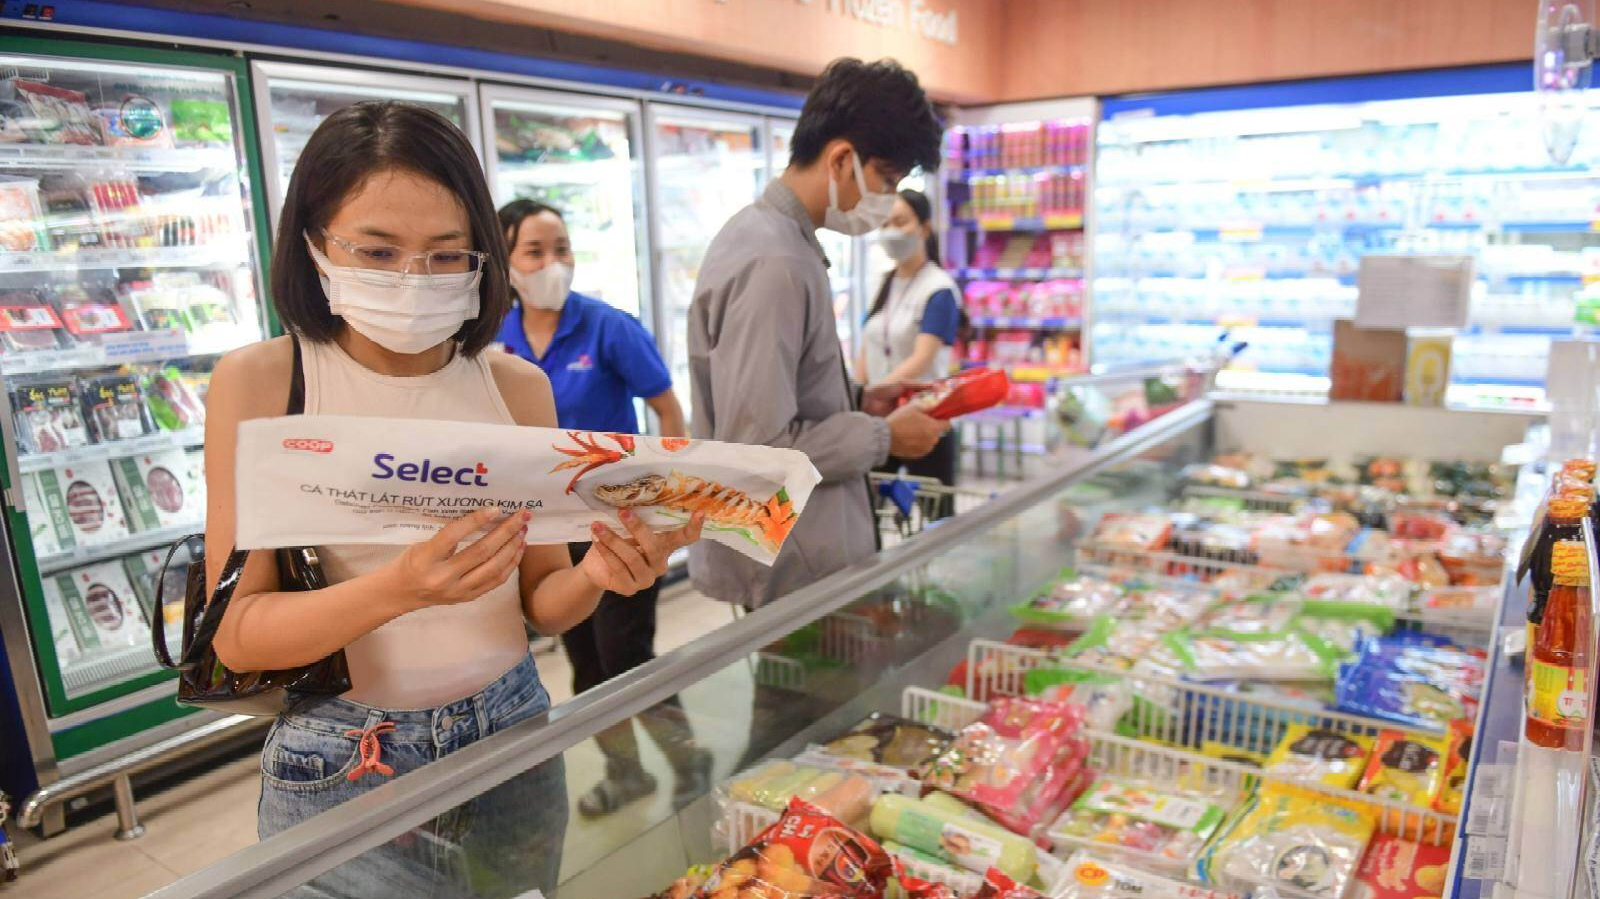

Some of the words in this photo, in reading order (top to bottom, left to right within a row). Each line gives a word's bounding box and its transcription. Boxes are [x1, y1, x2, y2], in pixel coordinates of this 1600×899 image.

[371, 453, 489, 487] Select
[402, 494, 435, 508] RÚT
[496, 499, 522, 511] KIM
